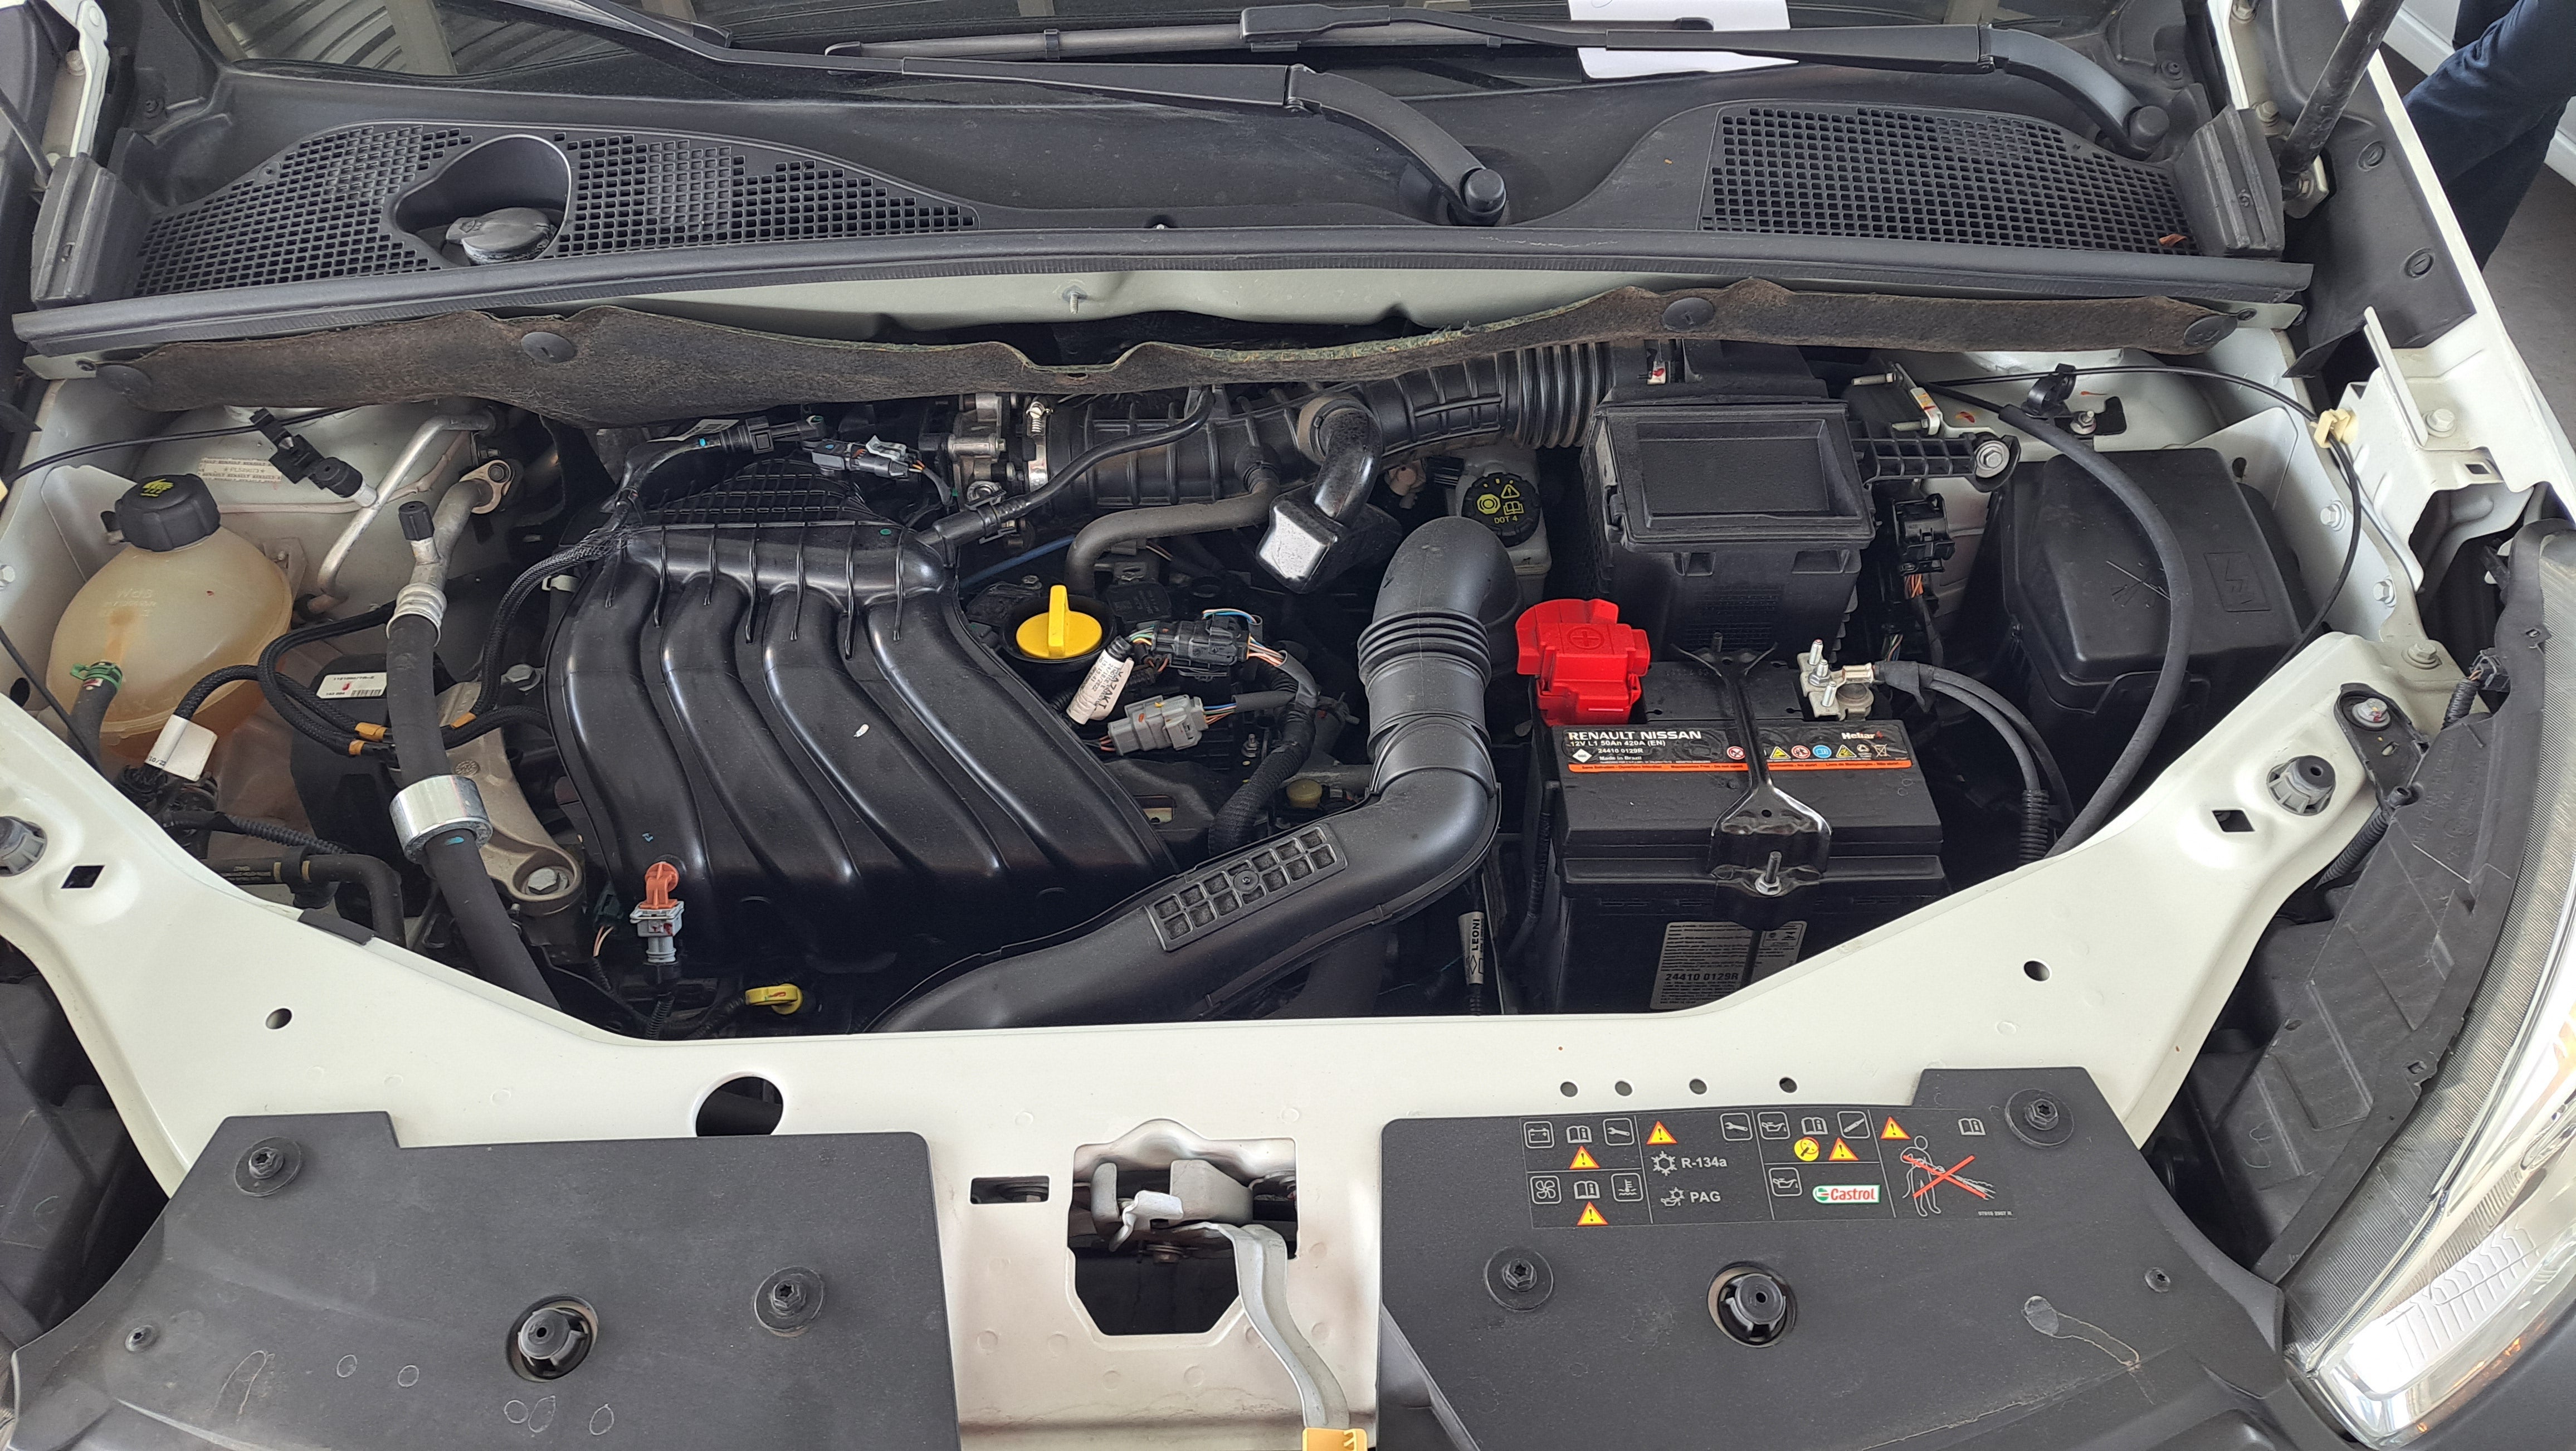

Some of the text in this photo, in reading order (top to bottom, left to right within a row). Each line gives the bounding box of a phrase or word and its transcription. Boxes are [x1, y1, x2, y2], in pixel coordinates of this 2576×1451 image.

[1569, 731, 1701, 740] RENAULT NISSAN
[1471, 919, 1480, 951] LEONI
[1704, 972, 1738, 981] 0129R
[1681, 1156, 1728, 1168] R-134a
[1690, 1191, 1721, 1203] PAG
[1831, 1188, 1876, 1201] Castrol
